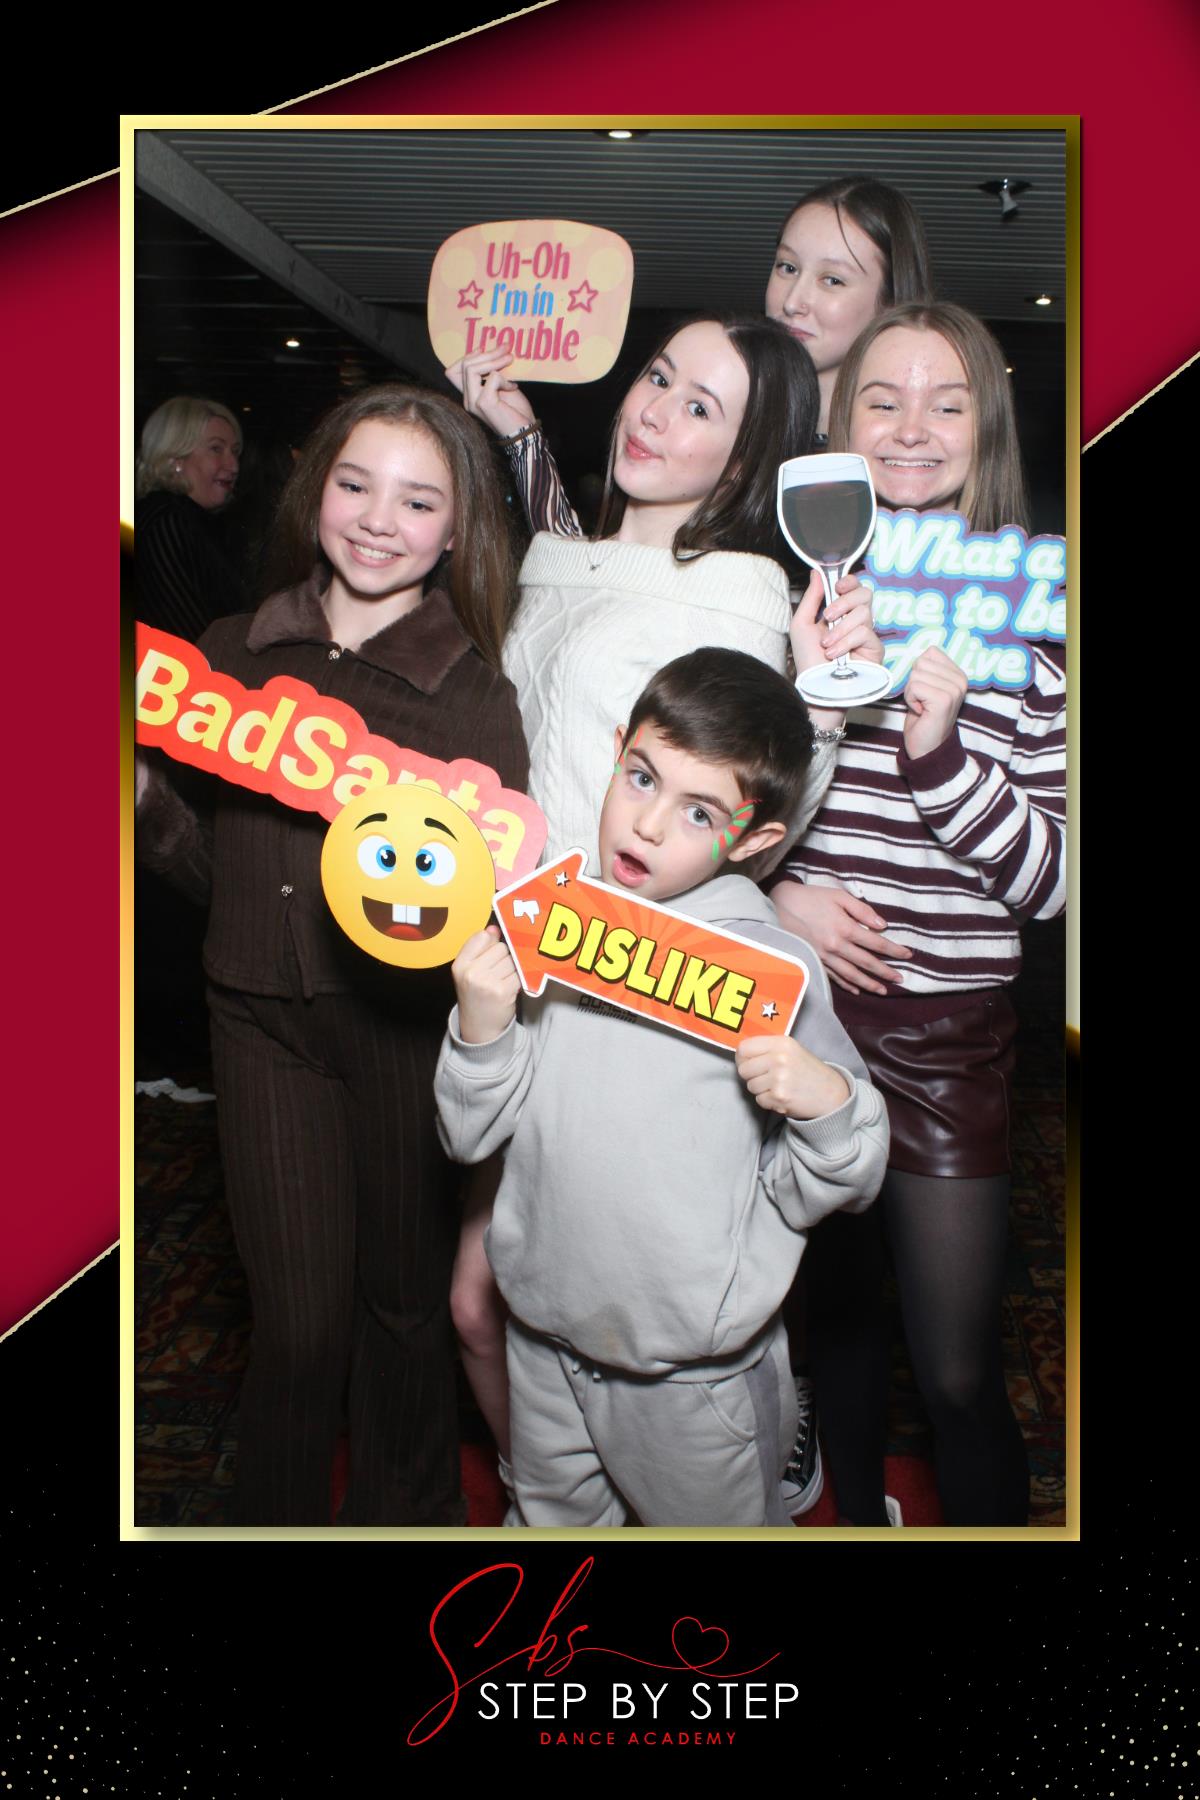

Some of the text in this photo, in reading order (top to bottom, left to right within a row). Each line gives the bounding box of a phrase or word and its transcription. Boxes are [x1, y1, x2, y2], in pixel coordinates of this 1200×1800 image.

[486, 241, 571, 280] Uh-Oh
[490, 282, 554, 316] I'm in
[464, 316, 580, 361] Trouble
[868, 516, 1065, 579] What a
[860, 579, 946, 627] me
[952, 584, 1009, 631] to
[538, 901, 755, 1032] DISLIKE
